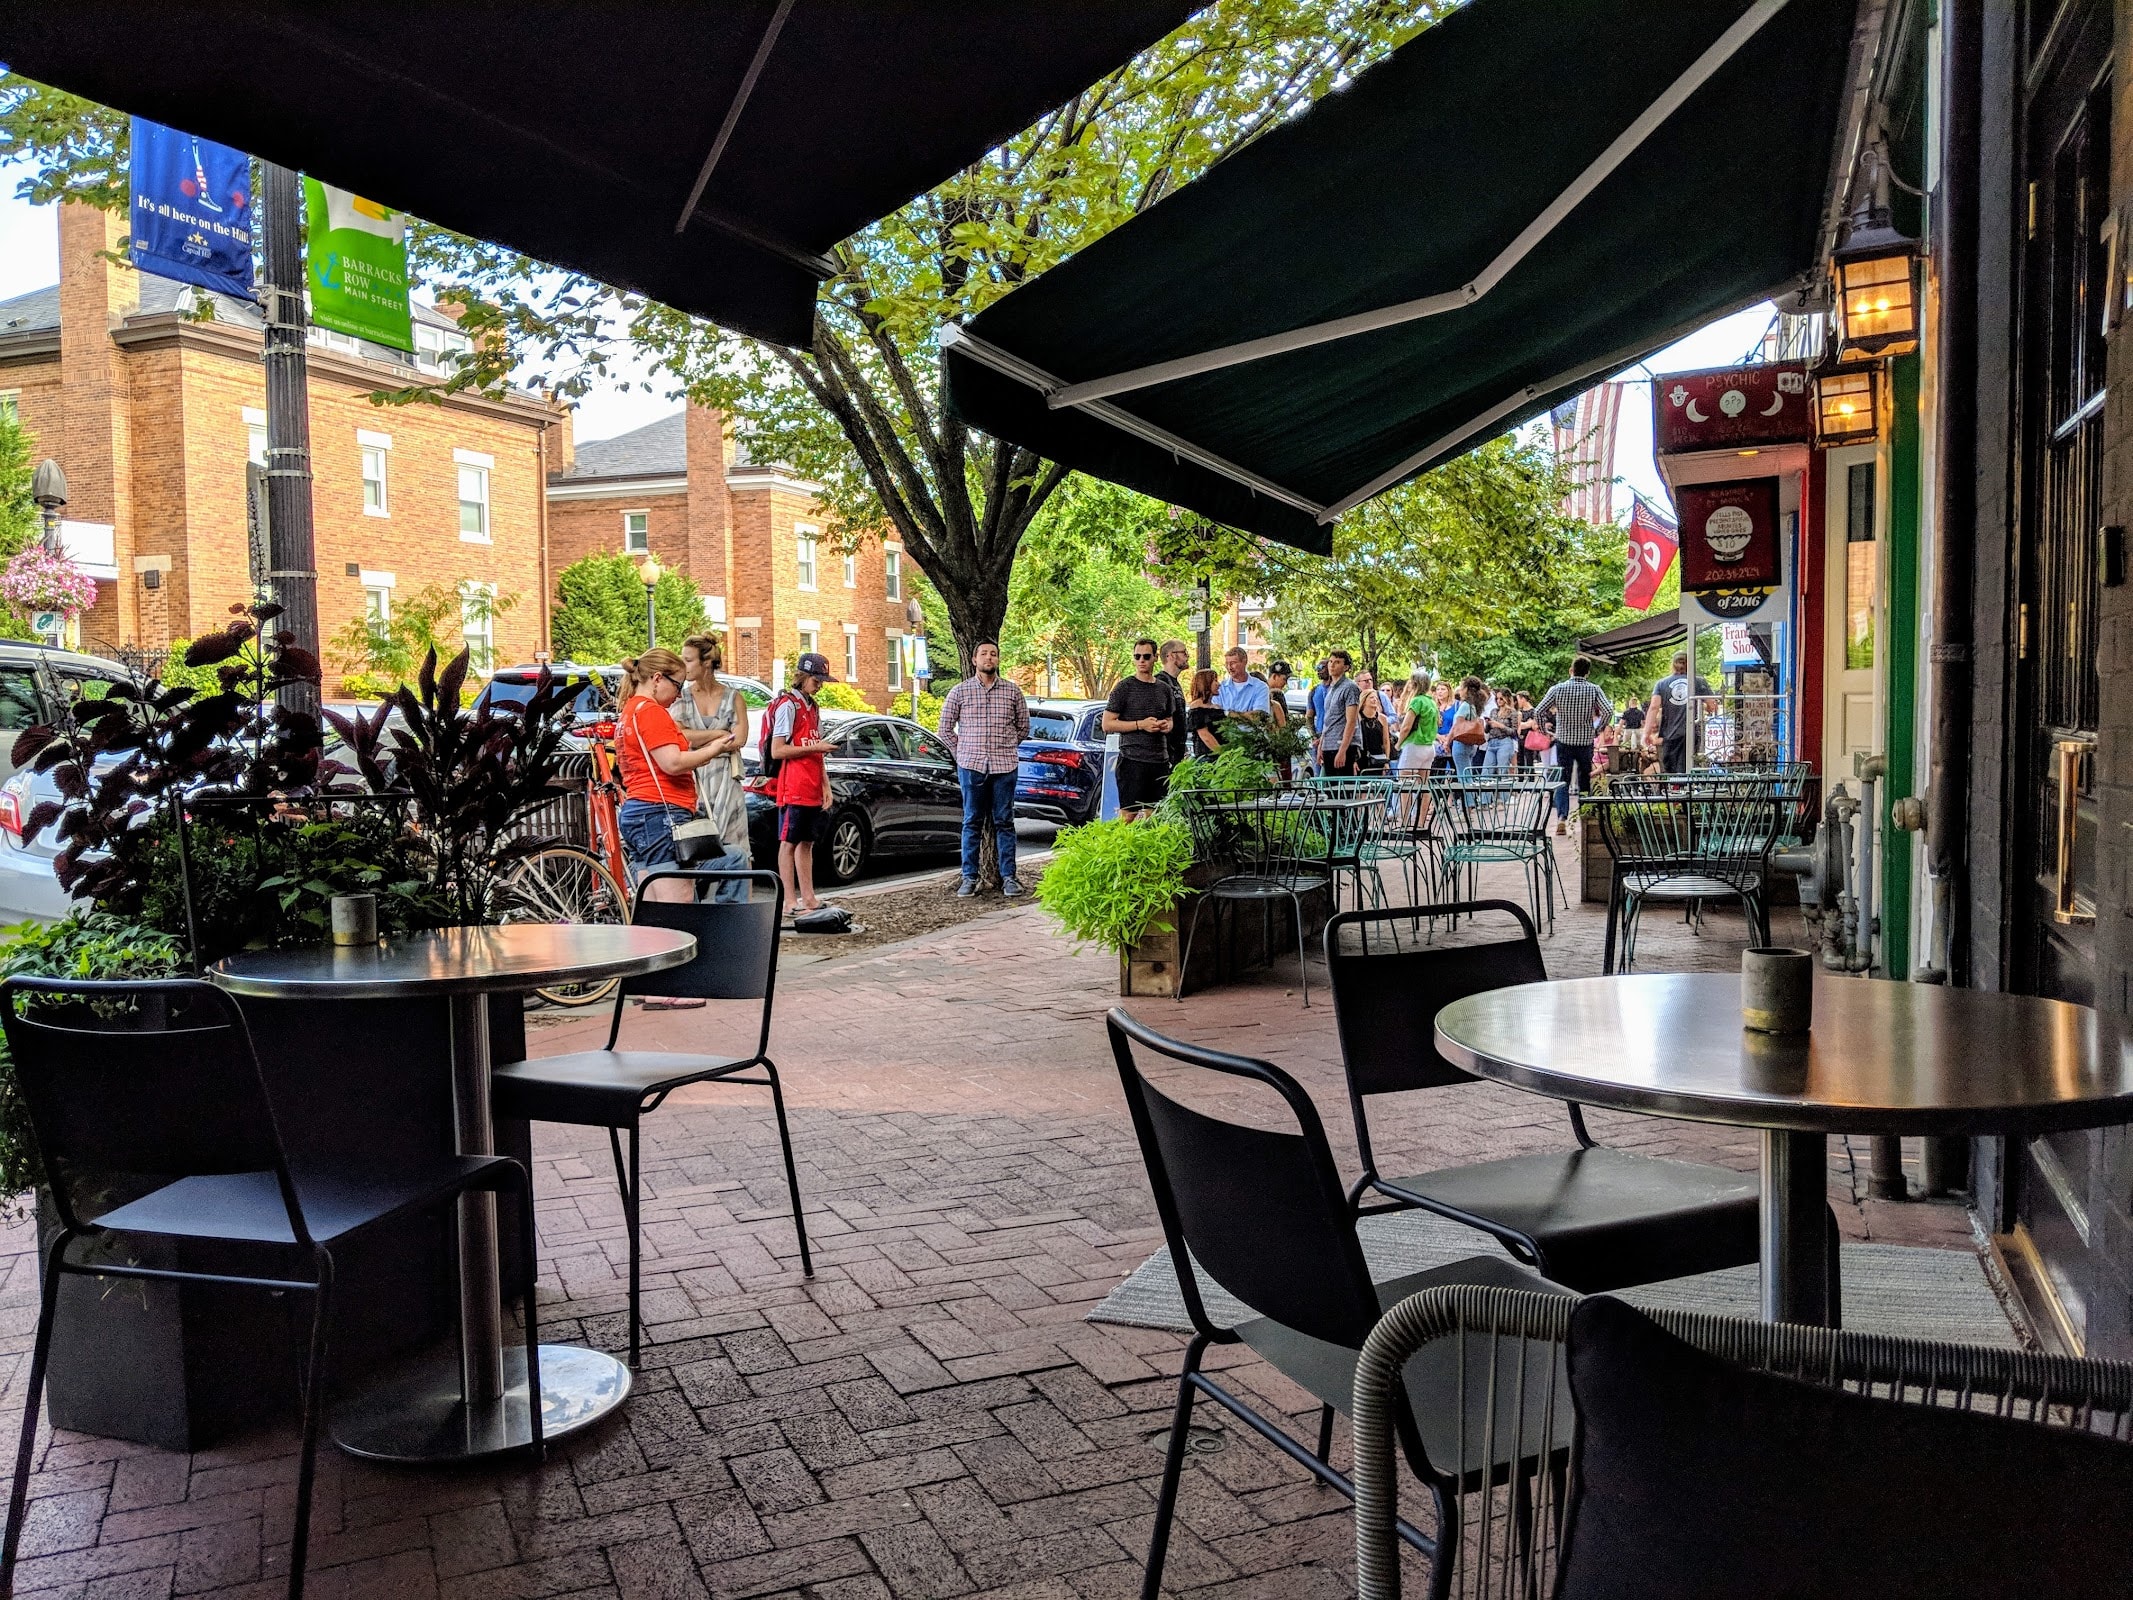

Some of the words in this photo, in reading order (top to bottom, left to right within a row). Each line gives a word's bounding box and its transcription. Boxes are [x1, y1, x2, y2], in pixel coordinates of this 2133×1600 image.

[138, 195, 155, 212] It's
[159, 204, 170, 217] all
[172, 207, 197, 226] here
[199, 219, 211, 230] on
[213, 222, 230, 236] the
[232, 227, 249, 244] Hill!
[342, 256, 402, 286] BARRACKS
[344, 272, 371, 289] ROW
[344, 286, 368, 300] MAIN
[371, 294, 404, 312] STREET
[1705, 371, 1761, 390] PSYCHIC
[1717, 596, 1732, 610] of
[1731, 595, 1761, 608] 2016
